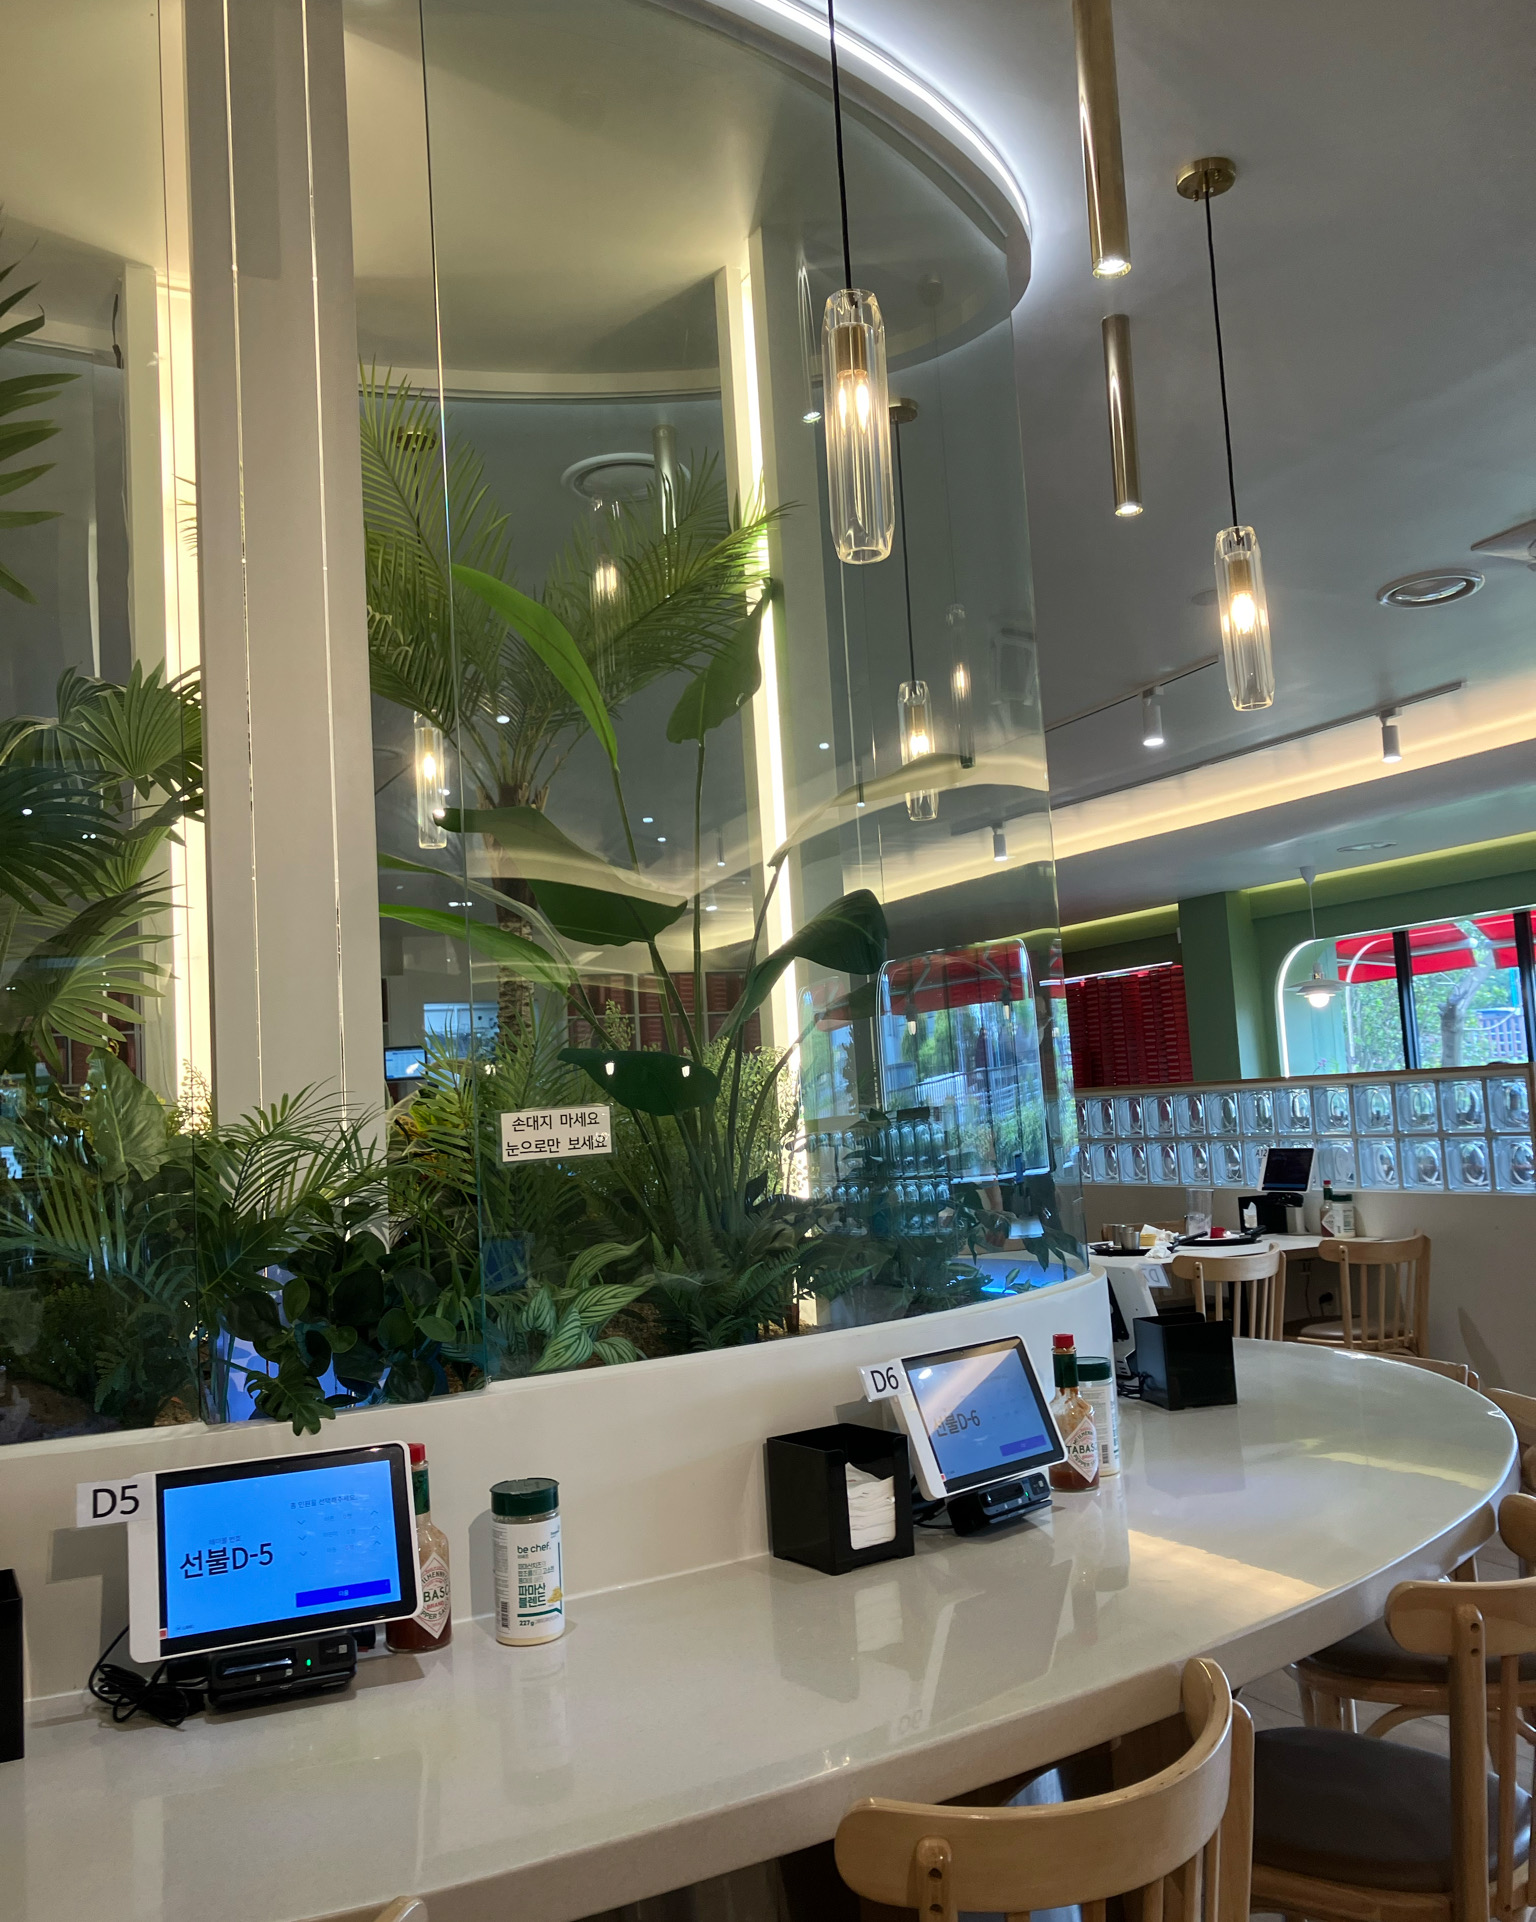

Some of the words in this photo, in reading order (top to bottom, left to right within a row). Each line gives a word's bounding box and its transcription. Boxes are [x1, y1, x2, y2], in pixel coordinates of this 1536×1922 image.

[512, 1114, 553, 1132] 손대지
[560, 1111, 600, 1128] 마세요
[505, 1137, 561, 1157] 눈으로만
[567, 1134, 608, 1151] 보세요
[870, 1366, 899, 1393] D6
[1066, 1443, 1096, 1455] TABAS
[92, 1484, 140, 1519] D5
[517, 1545, 529, 1554] be
[179, 1542, 274, 1580] 선불D-5
[423, 1584, 450, 1603] BASC
[518, 1582, 546, 1597] 파마산
